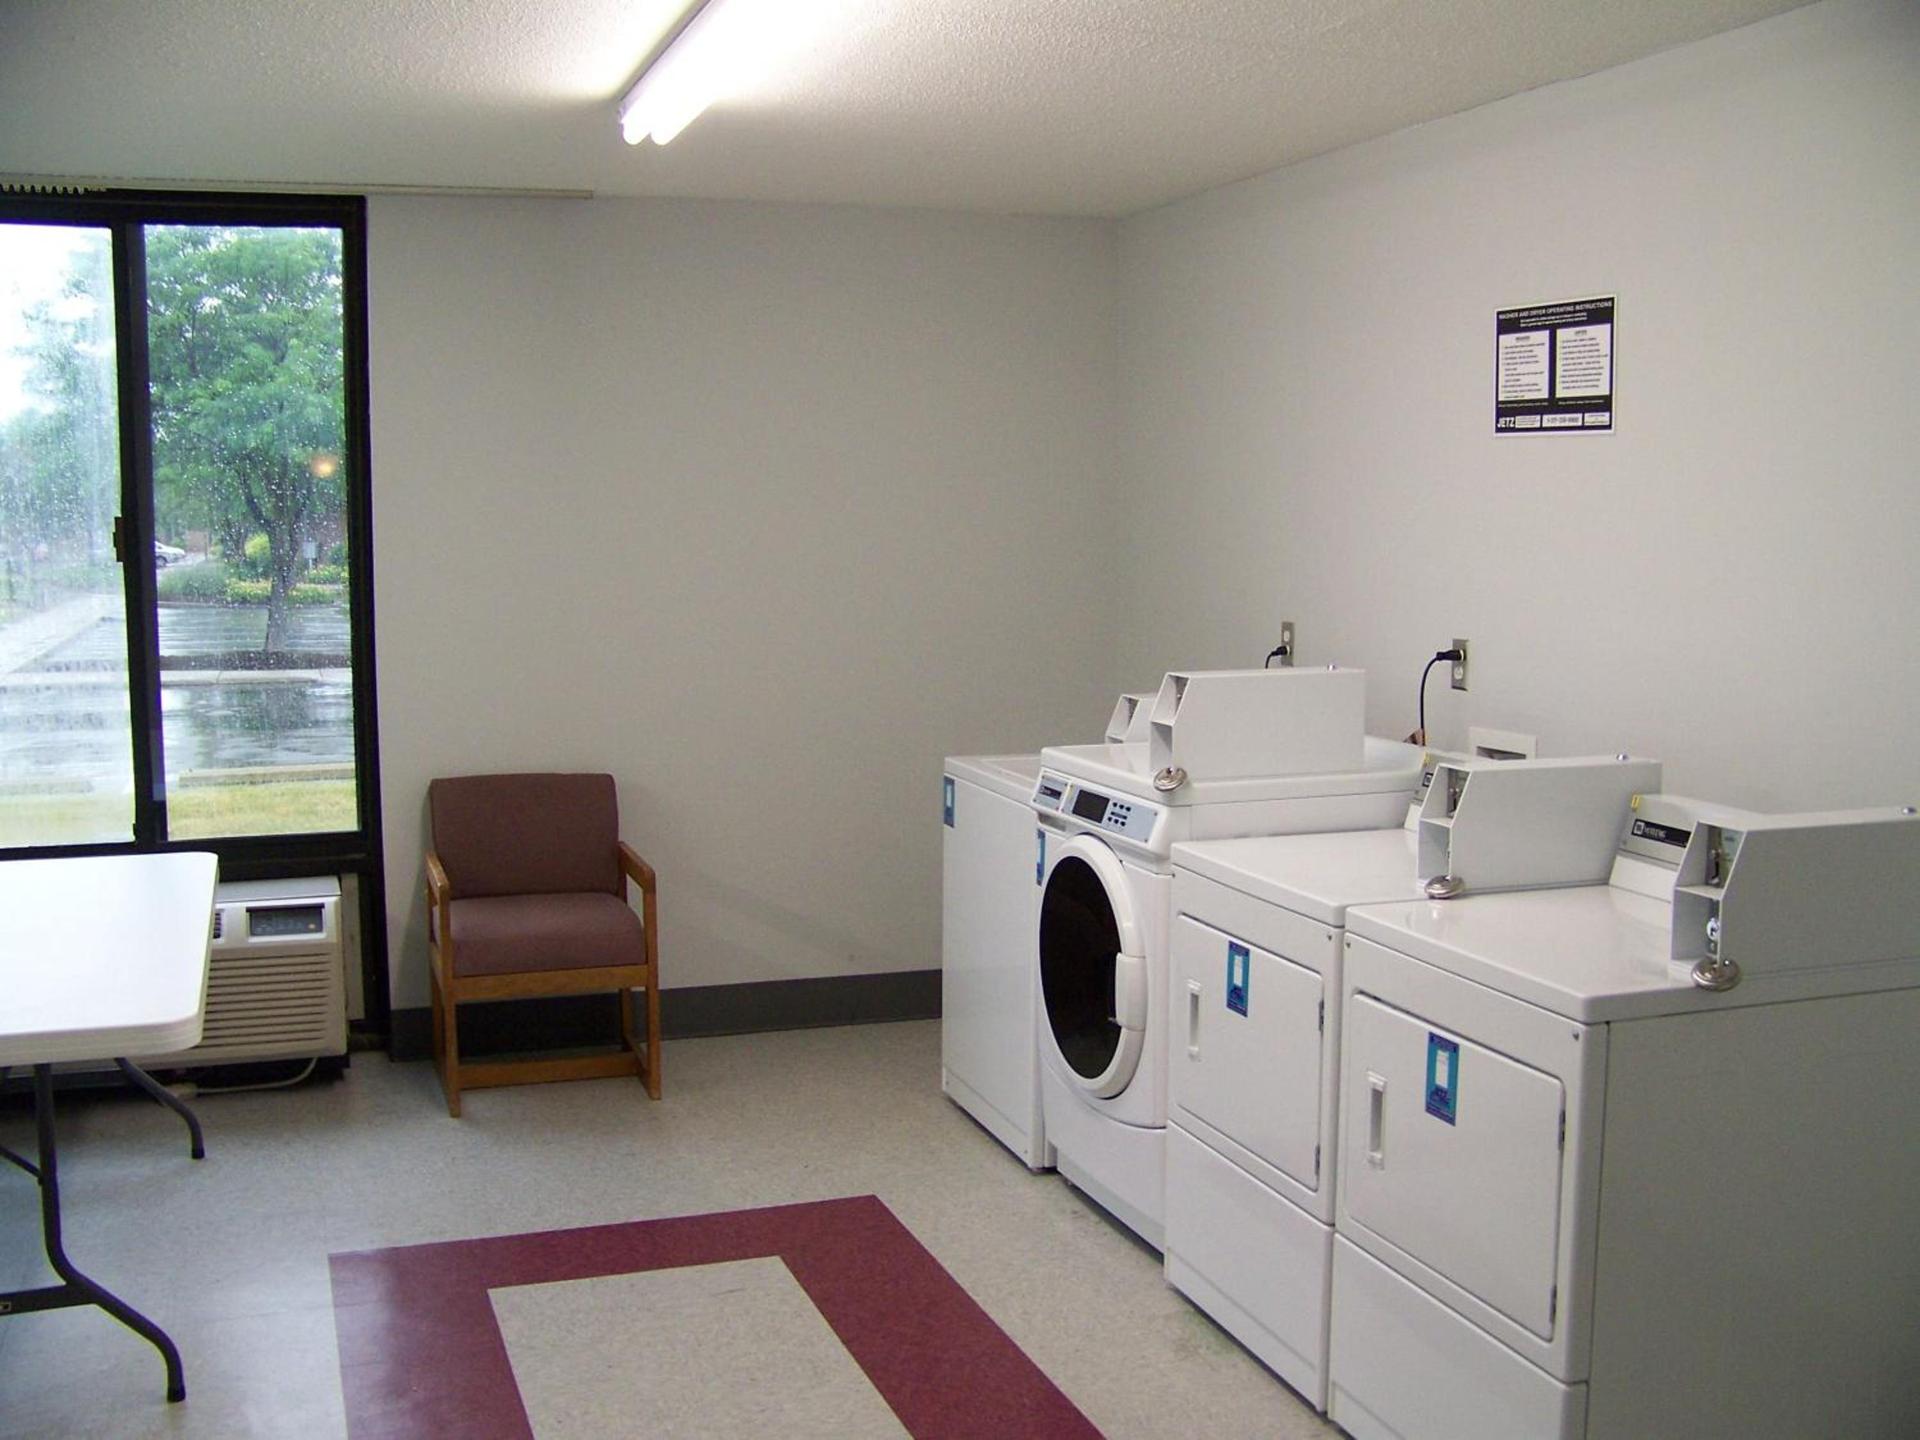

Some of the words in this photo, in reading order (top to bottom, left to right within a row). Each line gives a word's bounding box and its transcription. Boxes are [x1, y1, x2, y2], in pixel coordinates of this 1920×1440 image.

[1546, 305, 1574, 314] OPERATING
[1575, 301, 1612, 311] INSTRUCTIONS
[1497, 417, 1515, 428] JETZ
